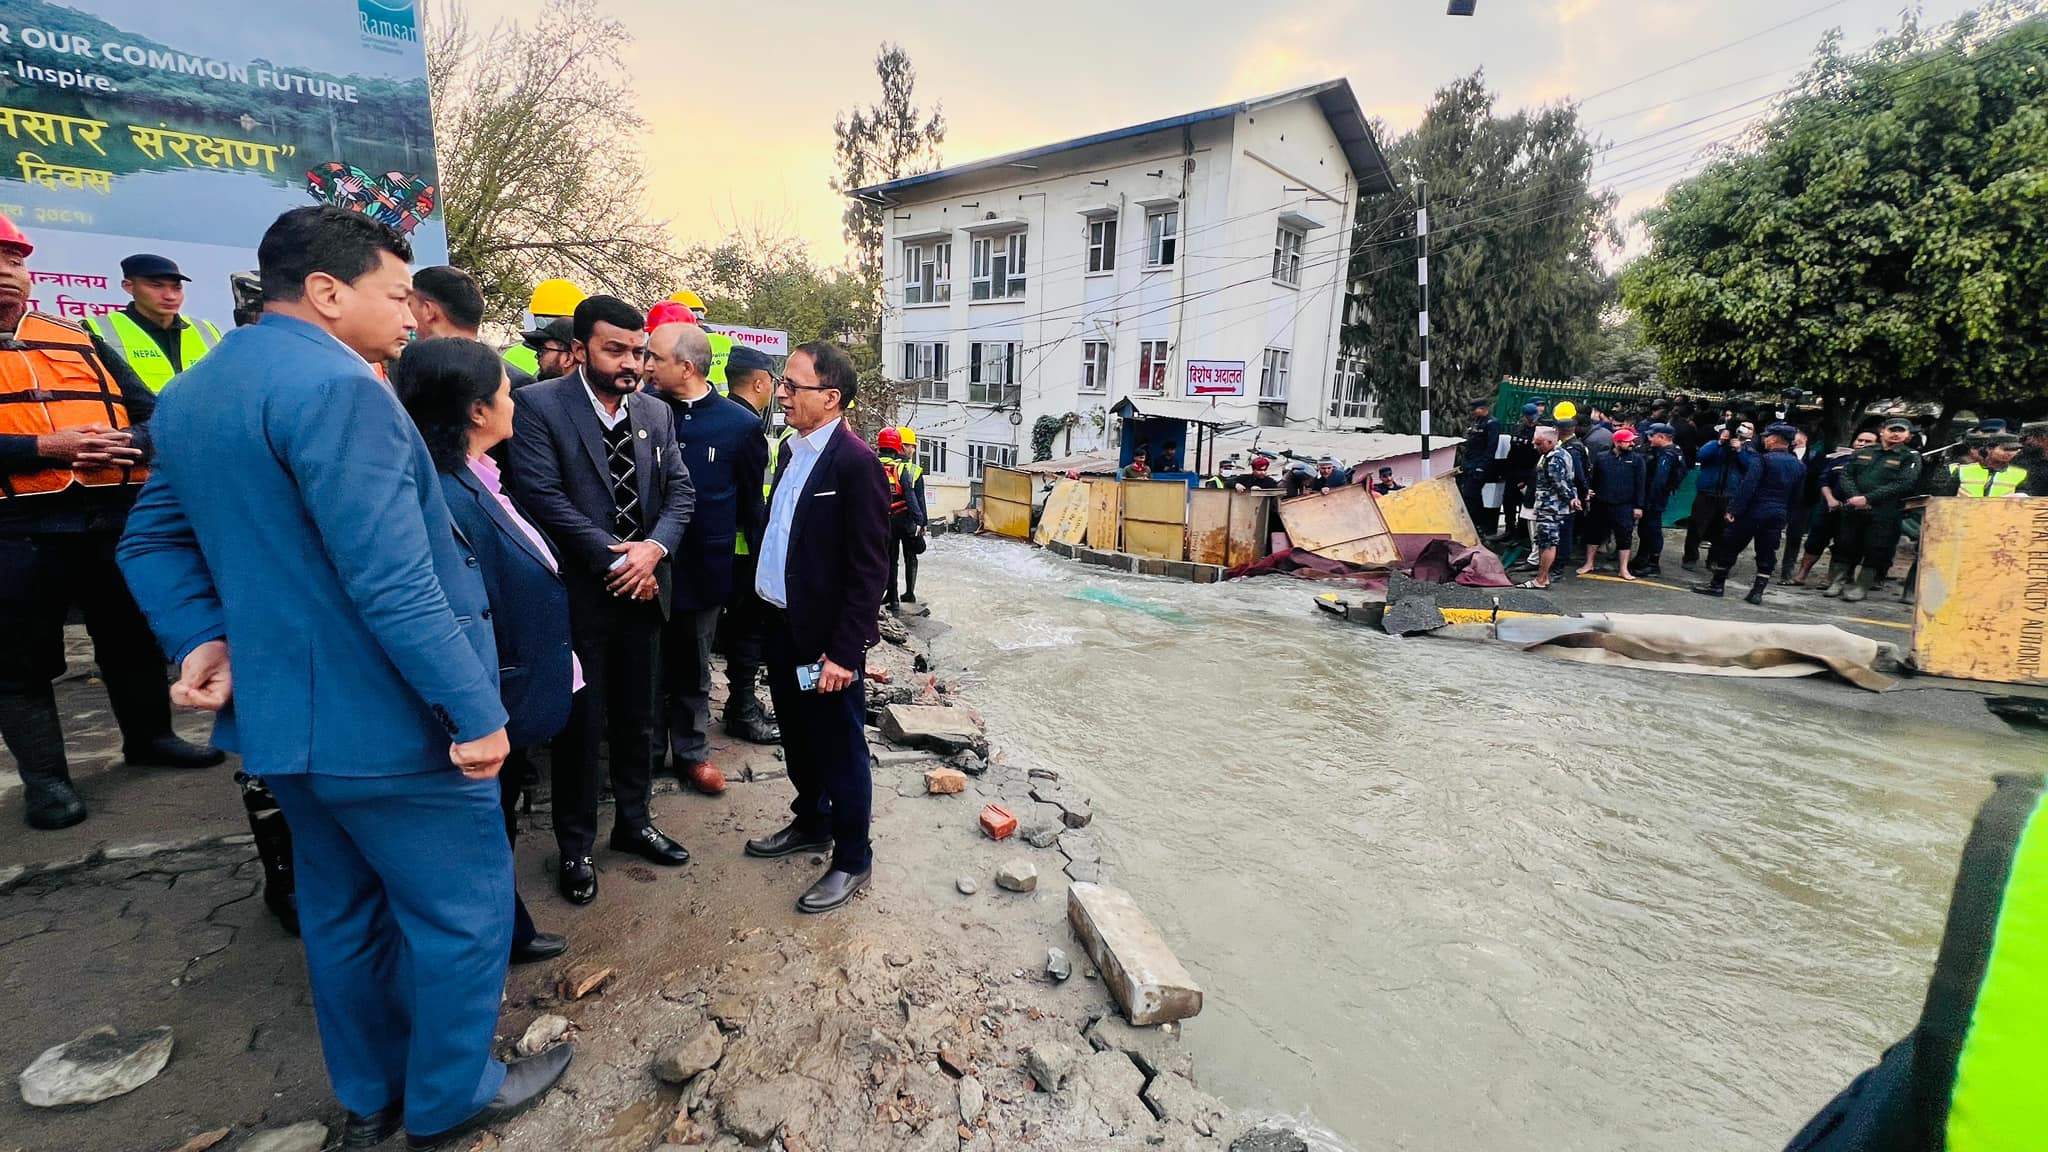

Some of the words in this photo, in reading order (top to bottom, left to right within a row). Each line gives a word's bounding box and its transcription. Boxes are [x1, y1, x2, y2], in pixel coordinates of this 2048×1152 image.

[359, 11, 416, 43] Ramsar
[16, 60, 118, 92] Inspire.
[21, 27, 95, 58] OUR
[102, 42, 249, 84] COMMON
[257, 69, 359, 104] FUTURE
[16, 151, 112, 196] दिवस
[133, 349, 161, 358] NEPAL
[1214, 369, 1243, 384] अदालत
[2023, 551, 2048, 615] ELECTRICITY
